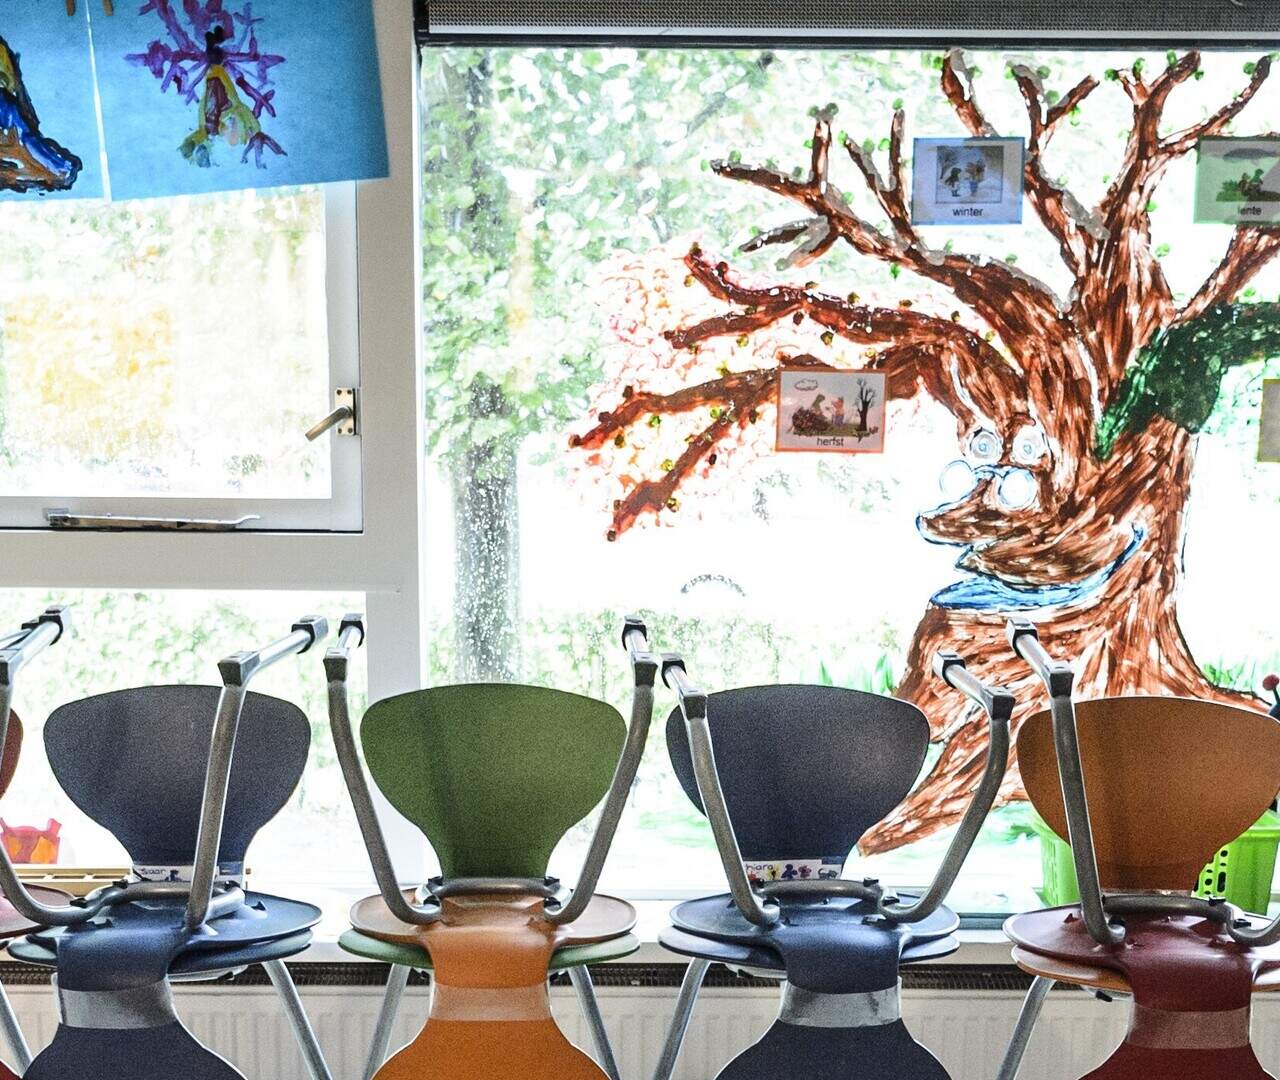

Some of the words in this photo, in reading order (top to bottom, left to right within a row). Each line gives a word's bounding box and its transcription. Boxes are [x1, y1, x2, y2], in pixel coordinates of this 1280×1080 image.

[952, 207, 984, 217] winter
[1238, 206, 1262, 216] lente
[816, 436, 844, 447] herfst
[744, 862, 774, 872] hiara
